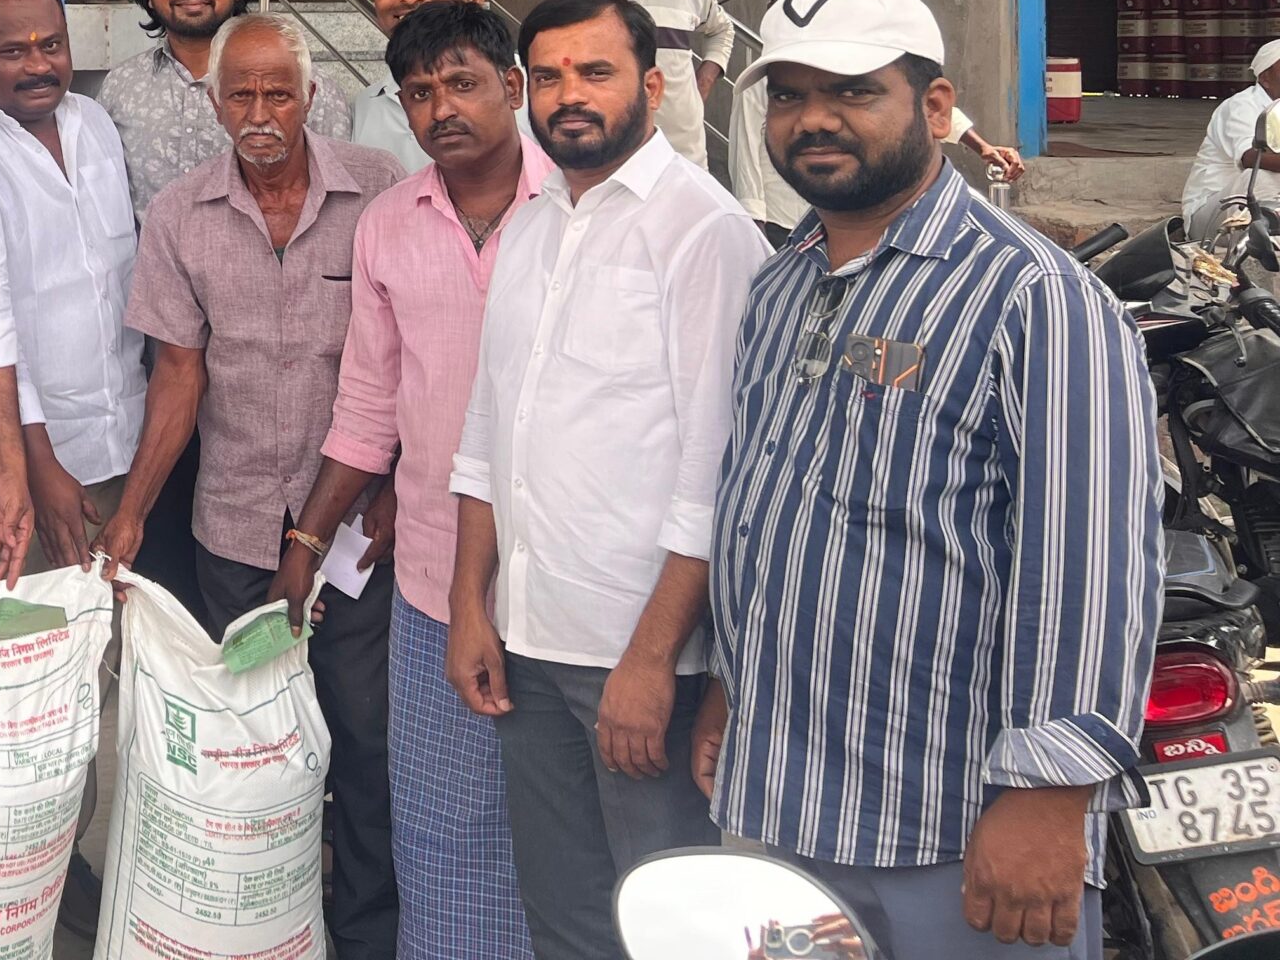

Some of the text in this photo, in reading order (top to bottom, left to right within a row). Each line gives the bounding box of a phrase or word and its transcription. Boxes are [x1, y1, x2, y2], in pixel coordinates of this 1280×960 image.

[166, 743, 197, 768] NSC
[1149, 764, 1271, 810] TG 35
[1178, 800, 1276, 843] 8745
[5, 897, 38, 921] निगम
